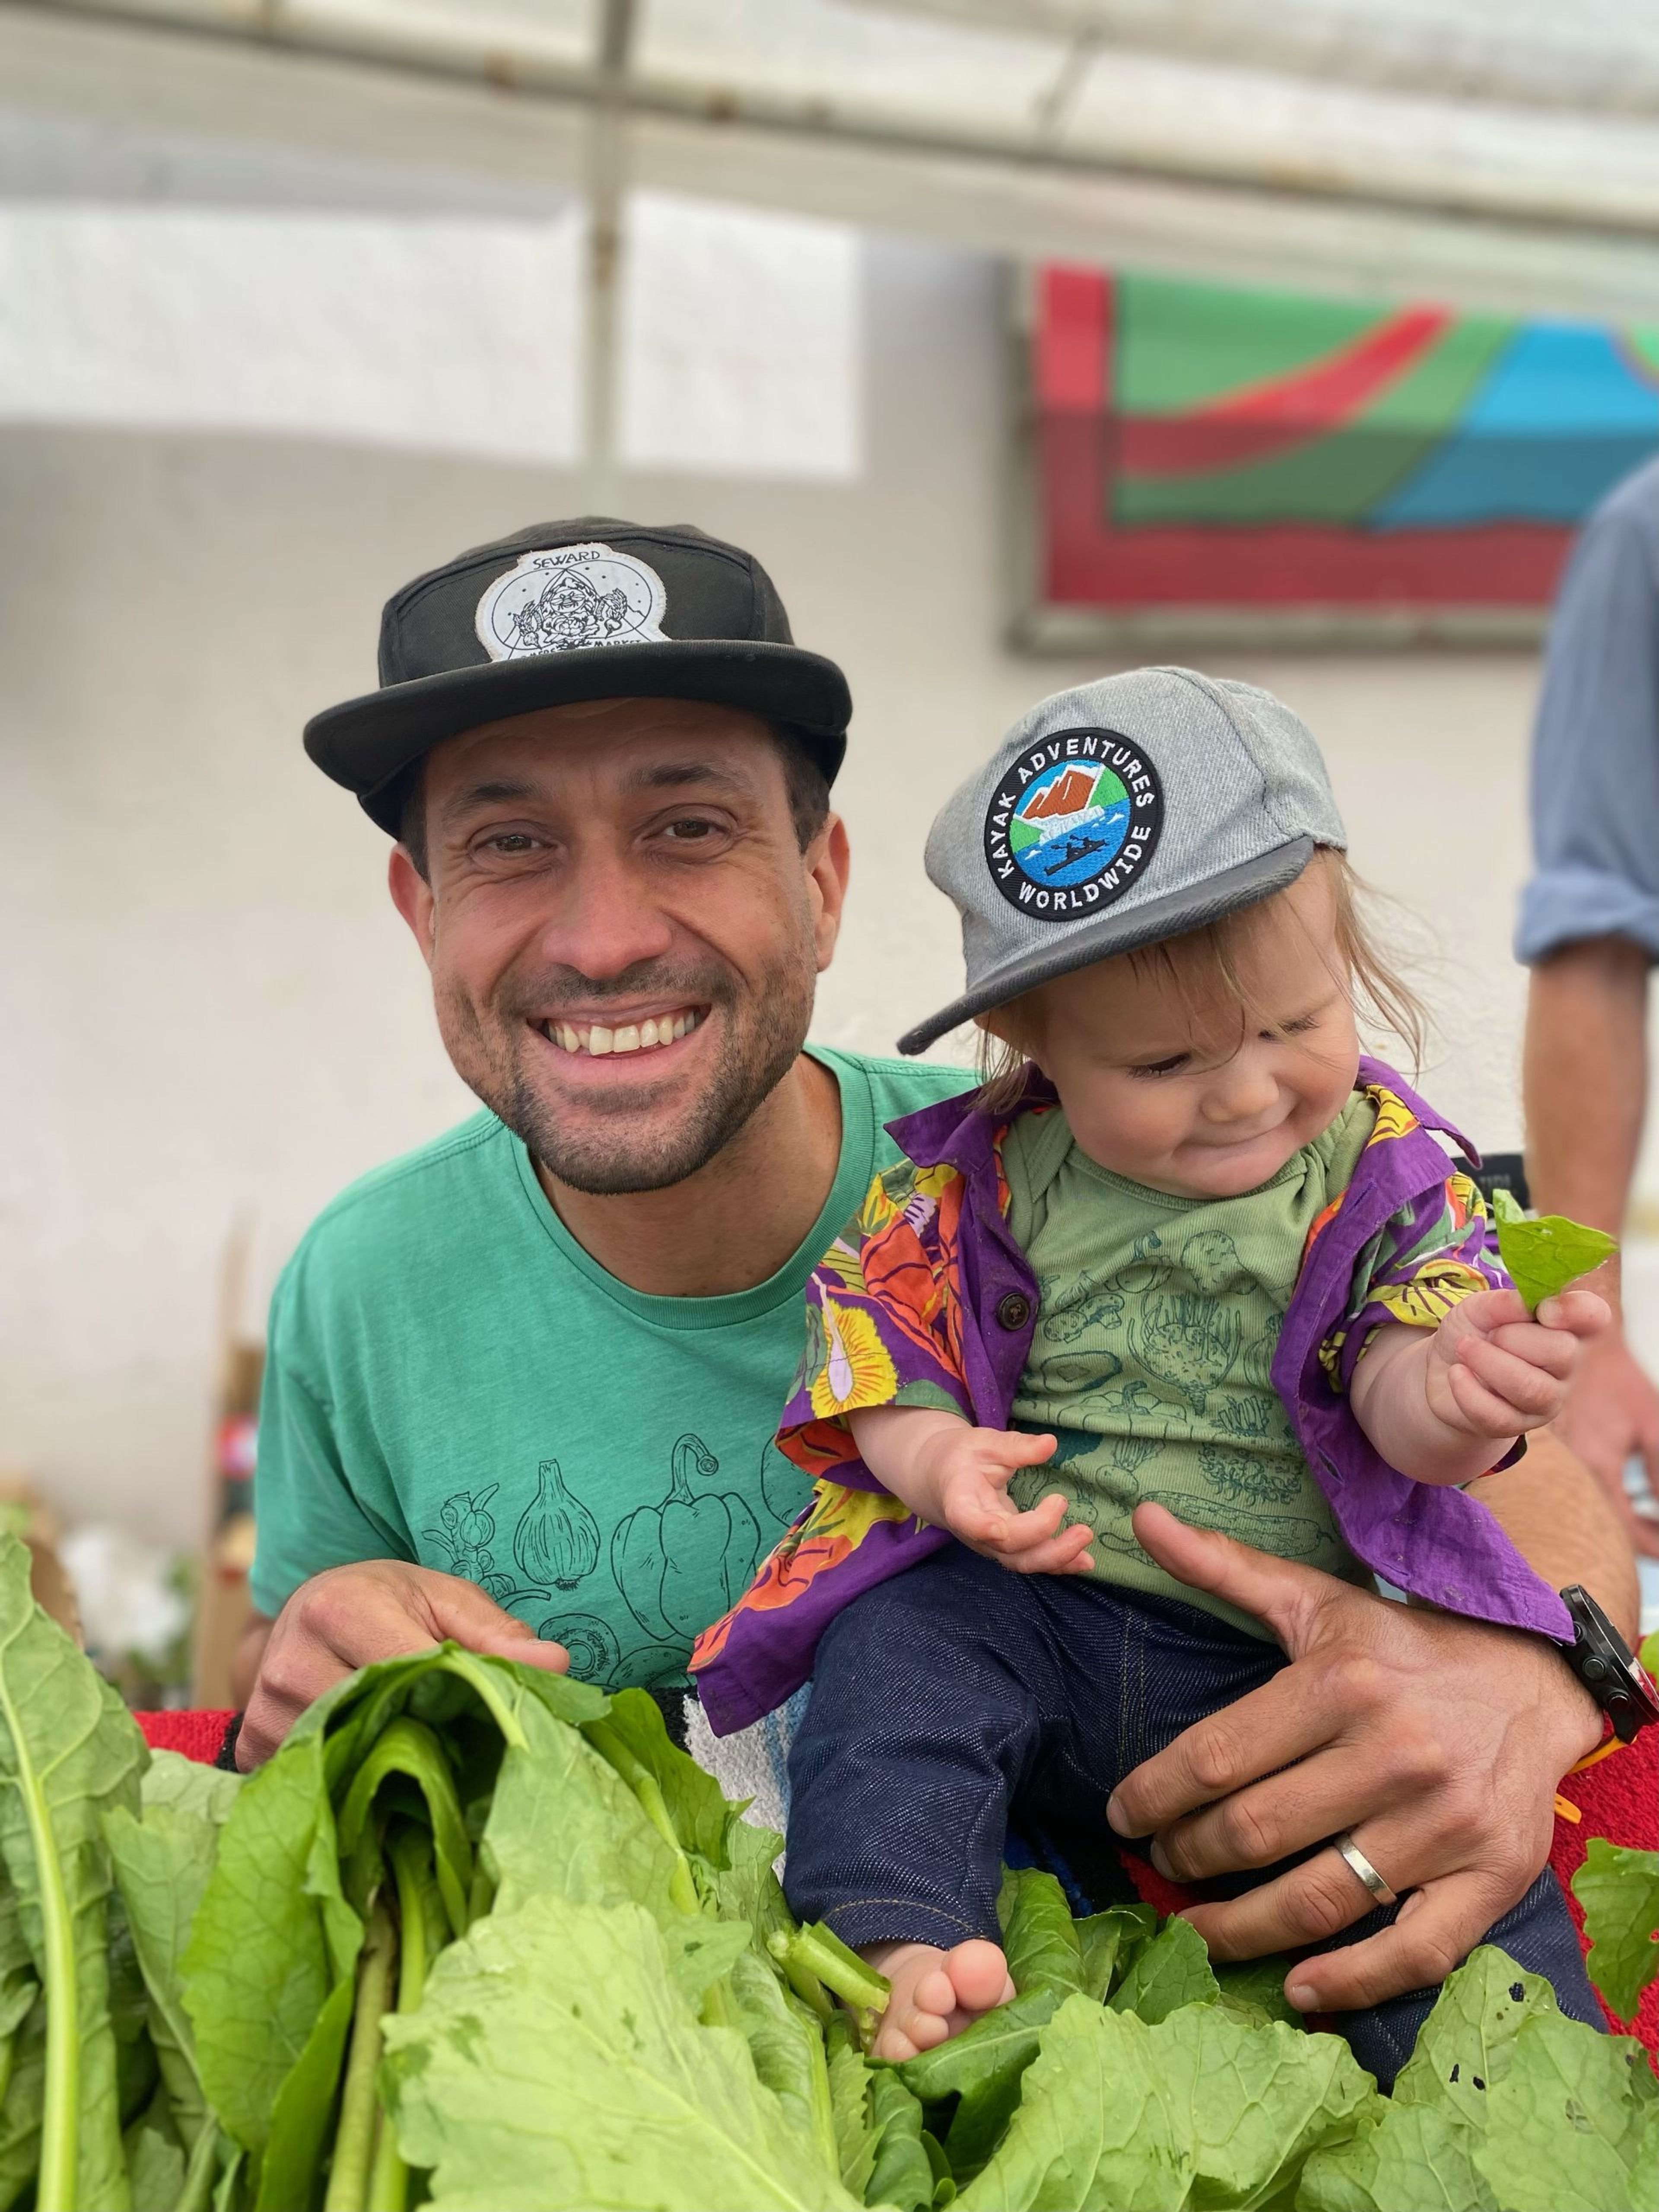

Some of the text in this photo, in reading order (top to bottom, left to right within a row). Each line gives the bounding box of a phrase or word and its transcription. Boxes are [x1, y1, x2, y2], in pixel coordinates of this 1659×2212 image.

[533, 551, 601, 570] SEWARD
[991, 736, 1155, 879] KAYAK ADVENTURES
[1018, 826, 1152, 910] WORLDWIDE
